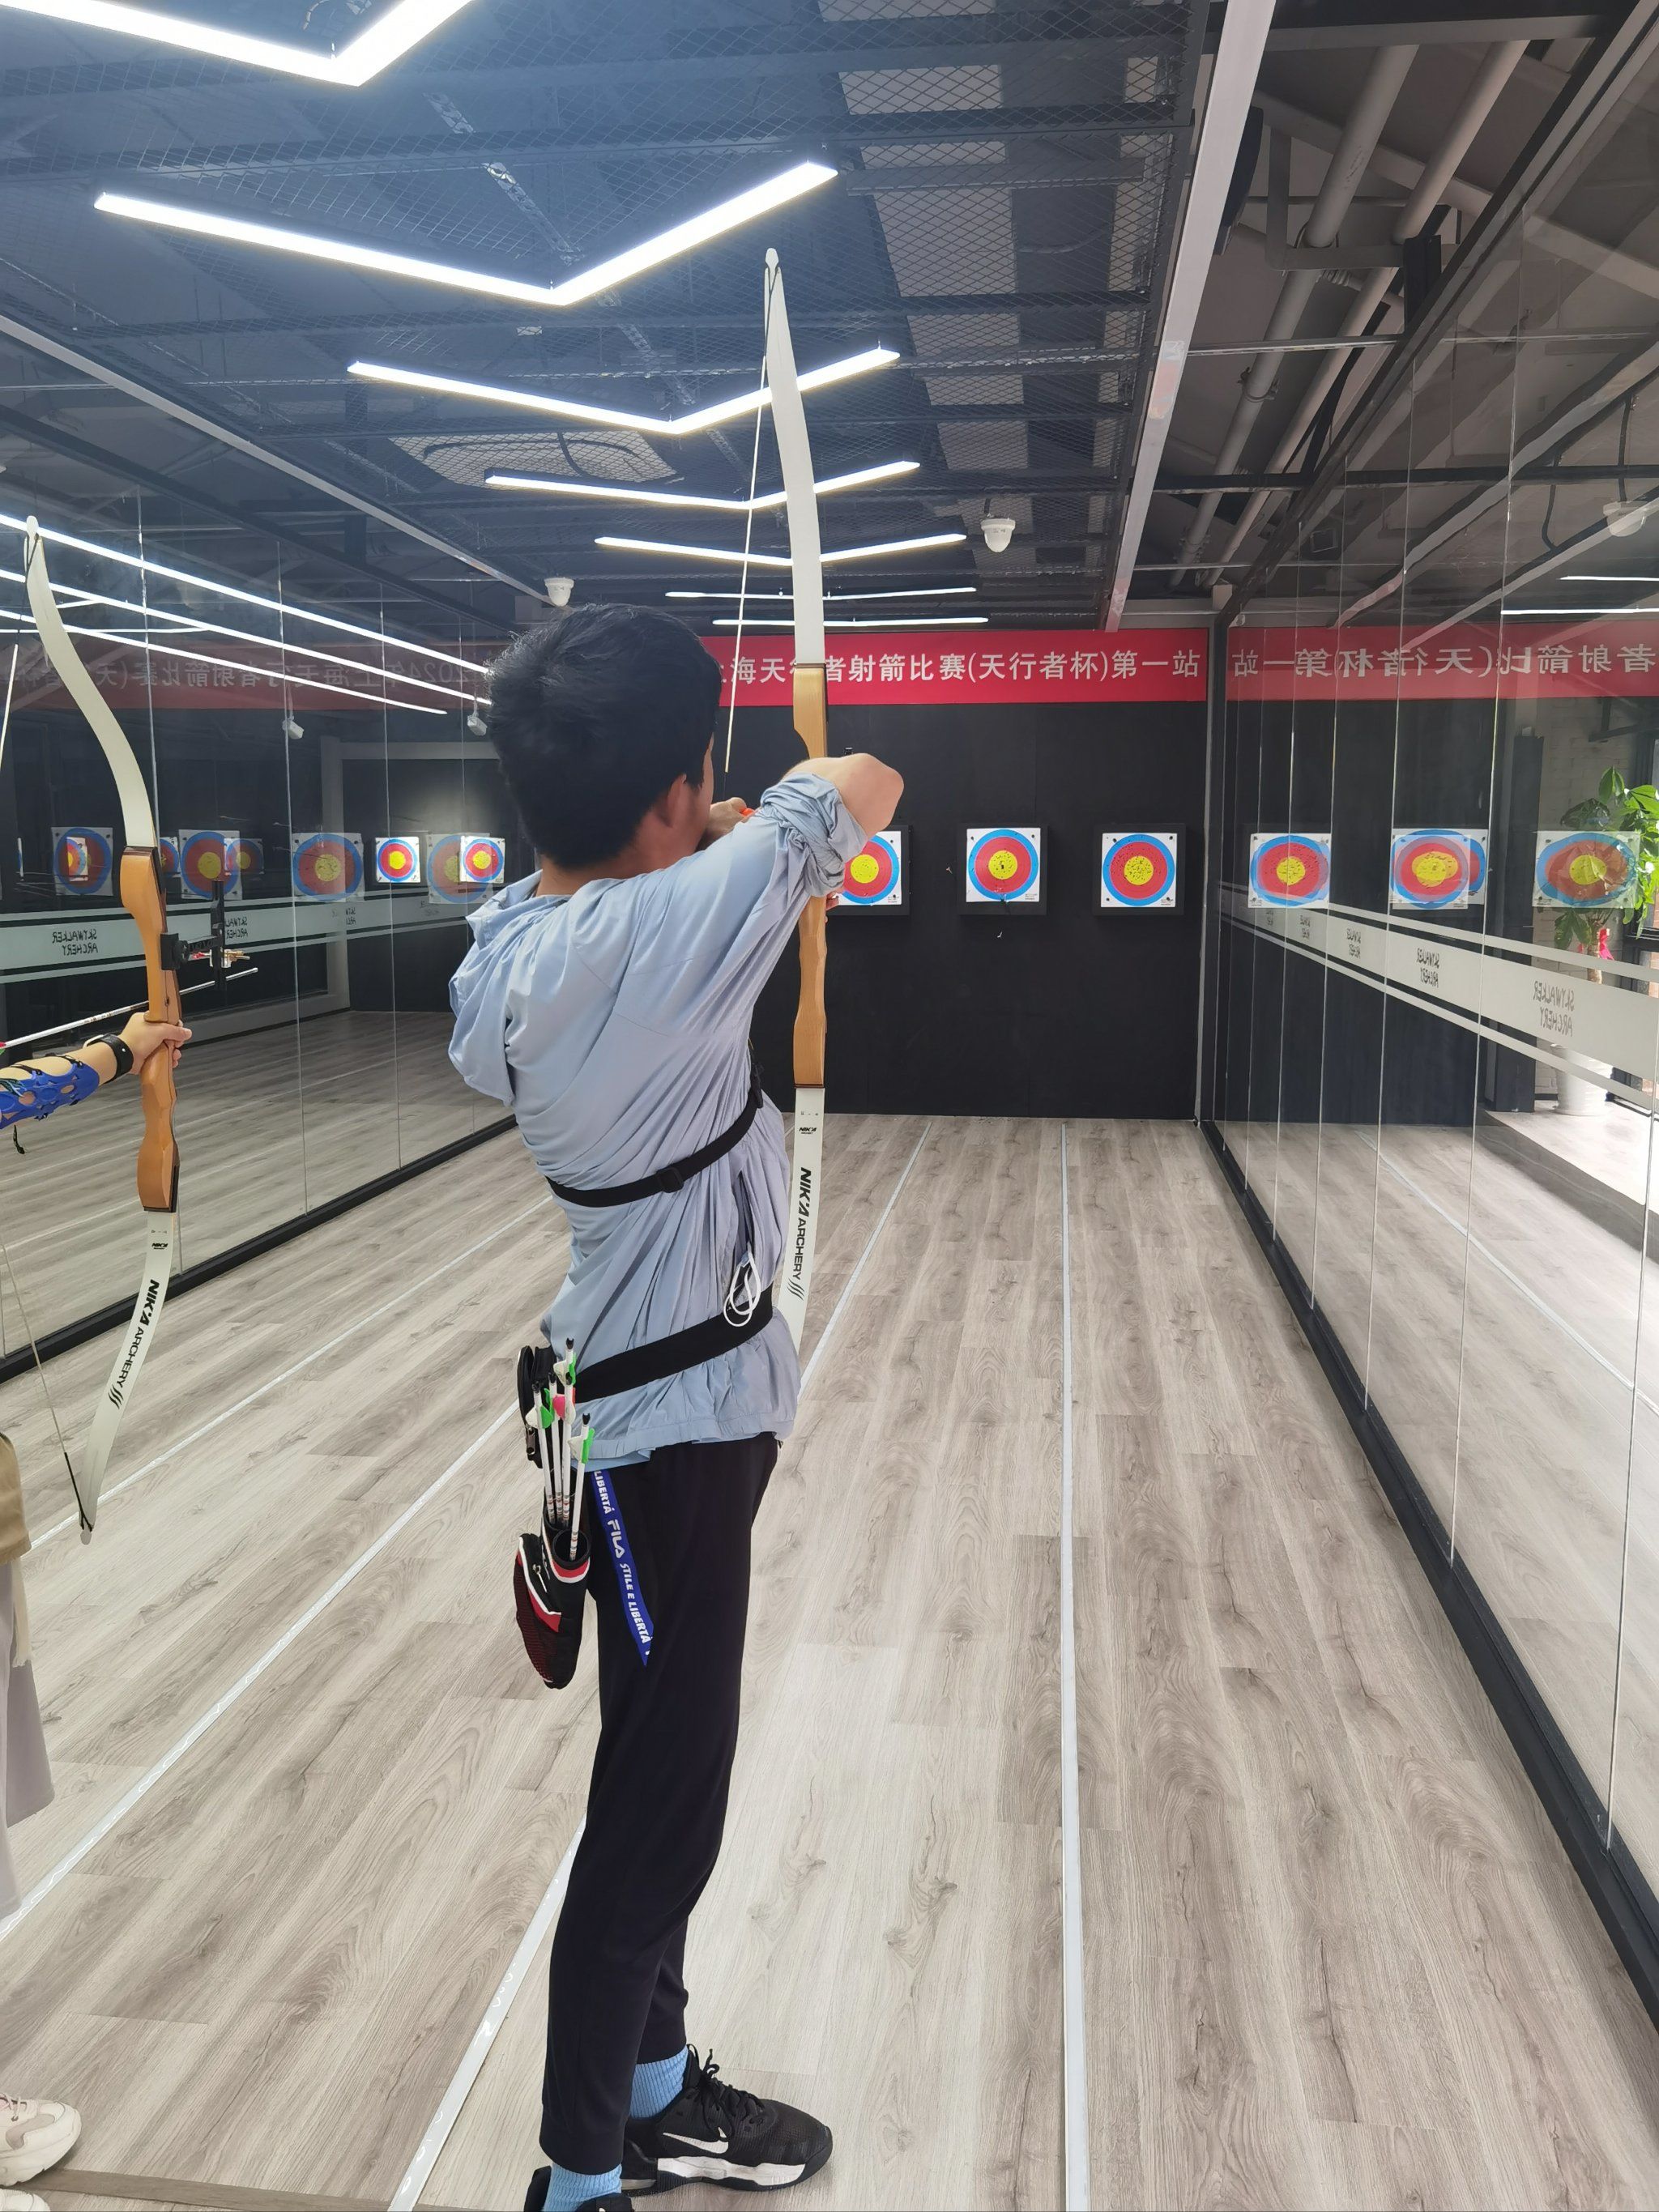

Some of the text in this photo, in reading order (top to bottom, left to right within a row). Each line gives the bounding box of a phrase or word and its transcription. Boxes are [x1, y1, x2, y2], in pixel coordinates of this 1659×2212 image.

[720, 650, 1201, 684] 海天者射箭比赛(天行者杯)第一站
[792, 1217, 807, 1281] ARCHERY
[116, 1326, 145, 1388] ARCHERY
[607, 1519, 625, 1559] FILA
[619, 1562, 633, 1591] STILE
